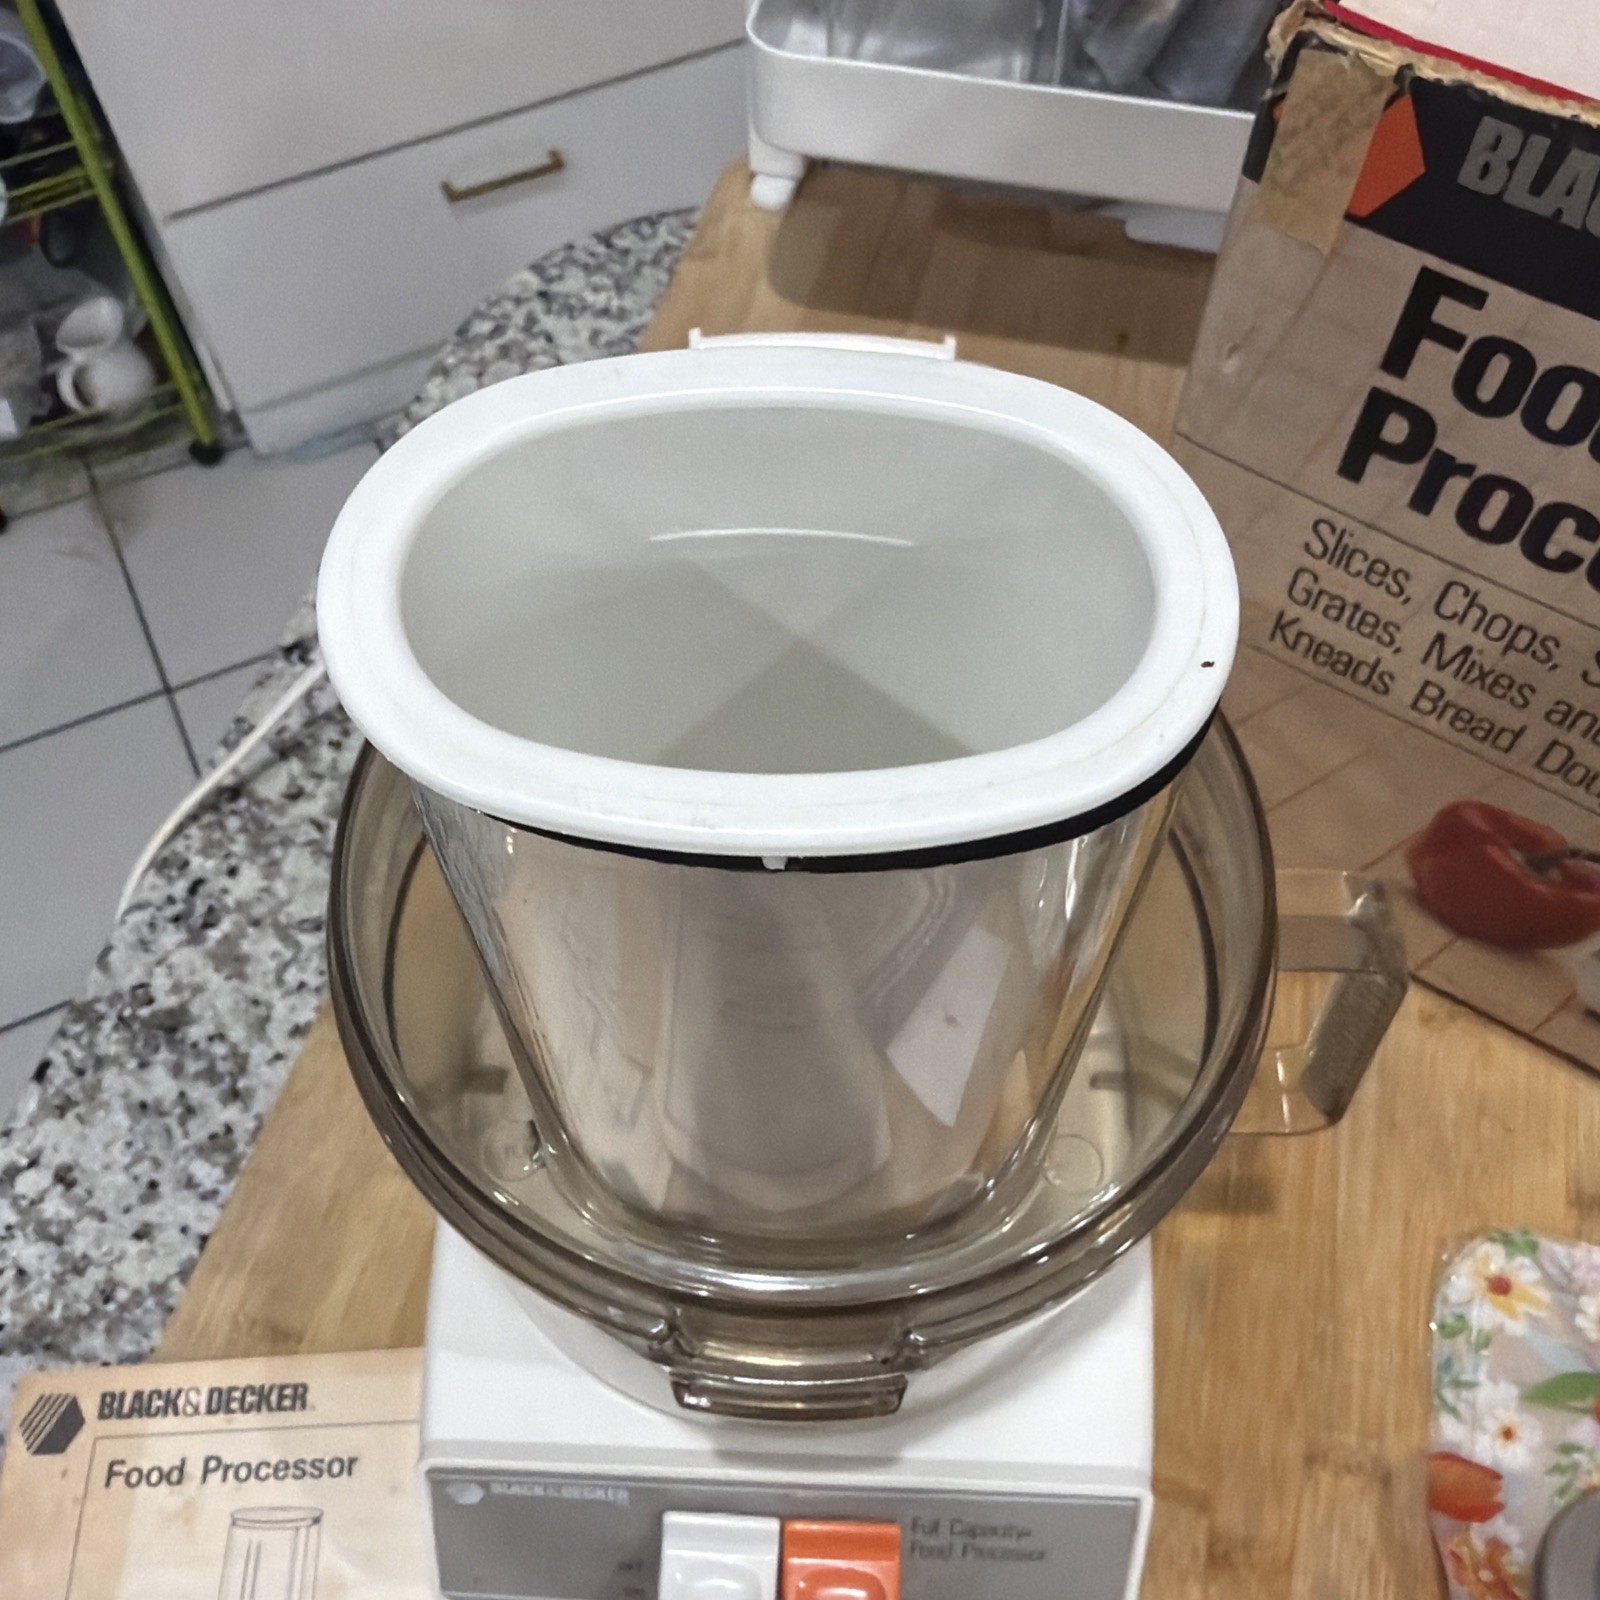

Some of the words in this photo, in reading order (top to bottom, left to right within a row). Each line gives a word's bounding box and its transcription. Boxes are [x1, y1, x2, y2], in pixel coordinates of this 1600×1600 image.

[1380, 266, 1600, 464] Foo
[1337, 387, 1600, 593] Proc
[1287, 566, 1402, 654] Grates,
[1421, 632, 1536, 709] Mixes
[1544, 700, 1600, 746] an
[1304, 518, 1412, 605] Slices,
[1433, 580, 1560, 672] Chops,
[1269, 610, 1395, 696] Kneads
[1410, 680, 1527, 754] Bread
[105, 1457, 186, 1489] Food
[200, 1454, 359, 1485] Processor
